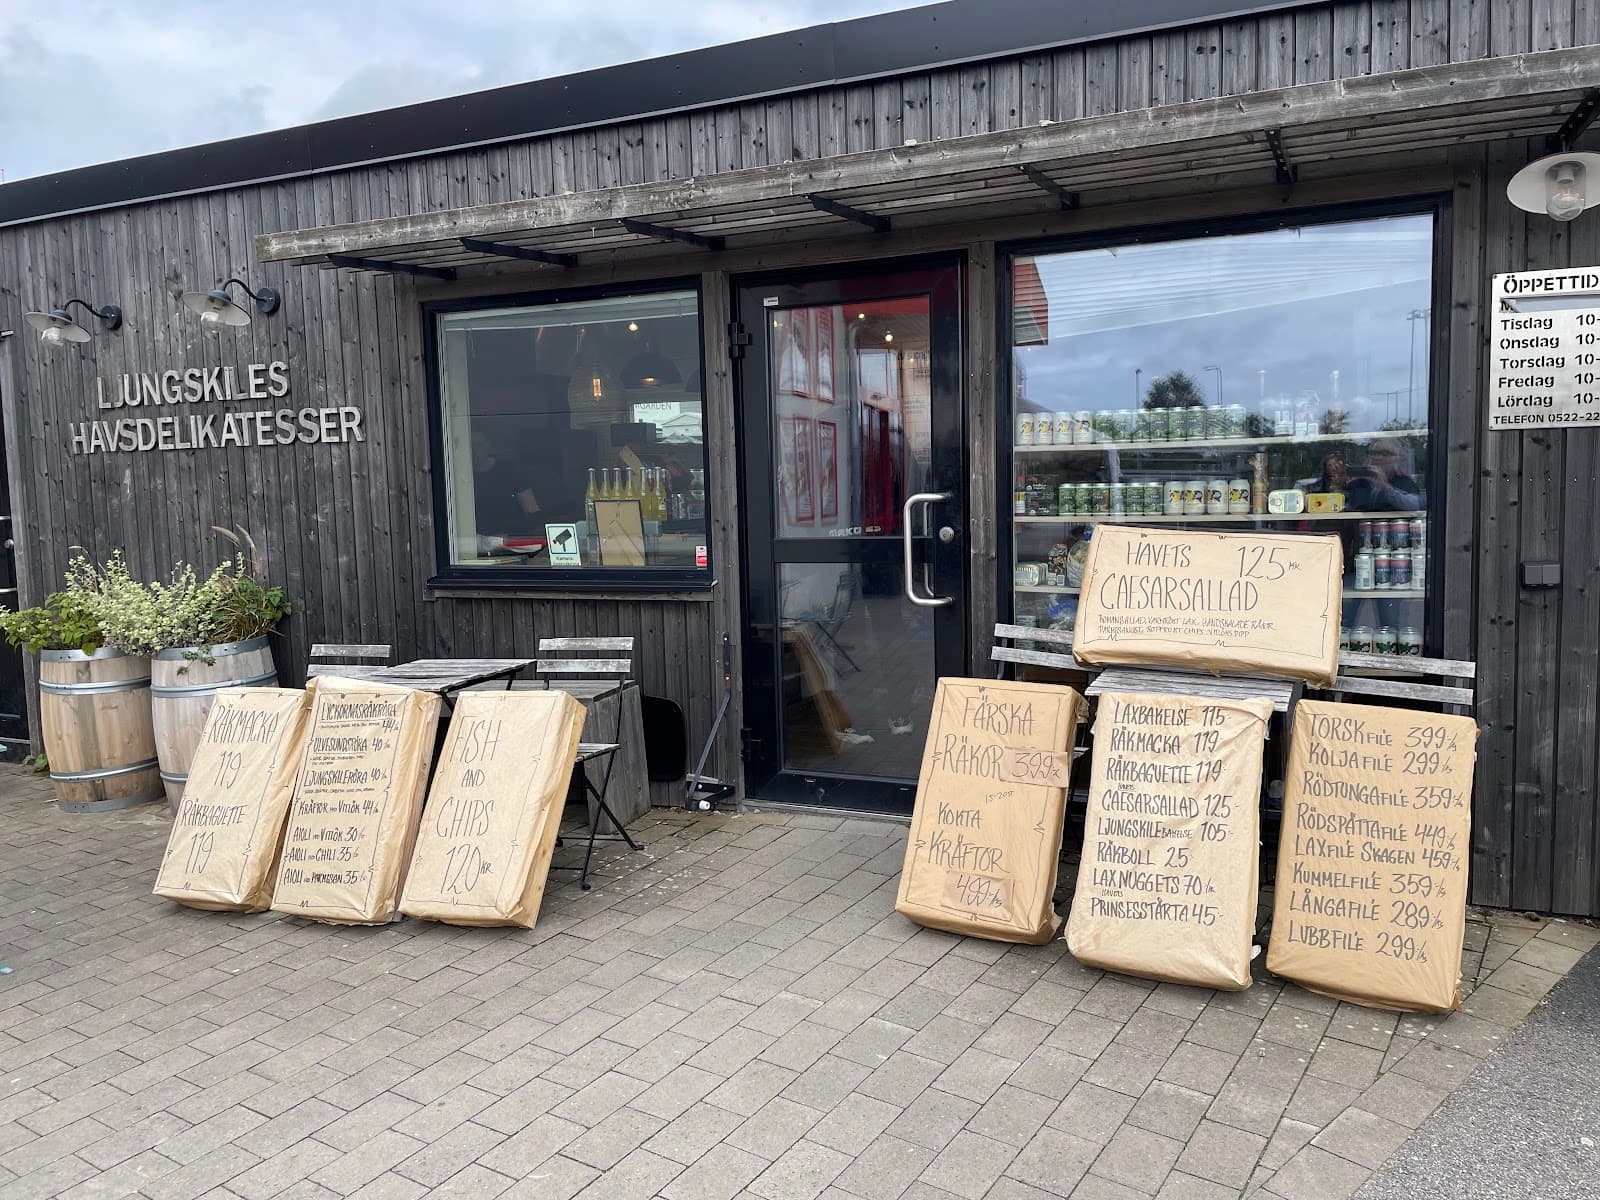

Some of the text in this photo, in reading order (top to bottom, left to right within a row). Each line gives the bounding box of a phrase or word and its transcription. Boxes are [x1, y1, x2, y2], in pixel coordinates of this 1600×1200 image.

[1500, 317, 1553, 330] Tisdag
[1500, 336, 1559, 349] Onsdag
[1500, 355, 1565, 369] Torsdag
[96, 360, 289, 409] LJUNGSKILES
[1498, 375, 1554, 388] Fredag
[1497, 395, 1553, 408] Lördag
[69, 406, 365, 454] HAVSDELIKATESSER
[1493, 414, 1544, 424] TELEFON
[1126, 541, 1192, 568] HAVETS
[1237, 545, 1290, 581] 125
[1100, 572, 1259, 612] CAESARSALLAD
[963, 695, 1035, 737] FÄRSKA
[1114, 701, 1192, 726] LAXBAKELSE
[449, 715, 502, 764] FISH
[941, 733, 1004, 779] RÄKOR
[1106, 755, 1192, 783] RÄKBAGUETTE
[461, 768, 485, 788] AND
[436, 796, 495, 839] CHIPS
[938, 801, 983, 829] KOKTA
[1101, 789, 1199, 819] CAESARSALLAD
[927, 830, 1010, 874] KRÄFTOR
[1097, 840, 1156, 865] RÄKBOLL
[1091, 896, 1189, 922] PRINSESSTÅRTA
